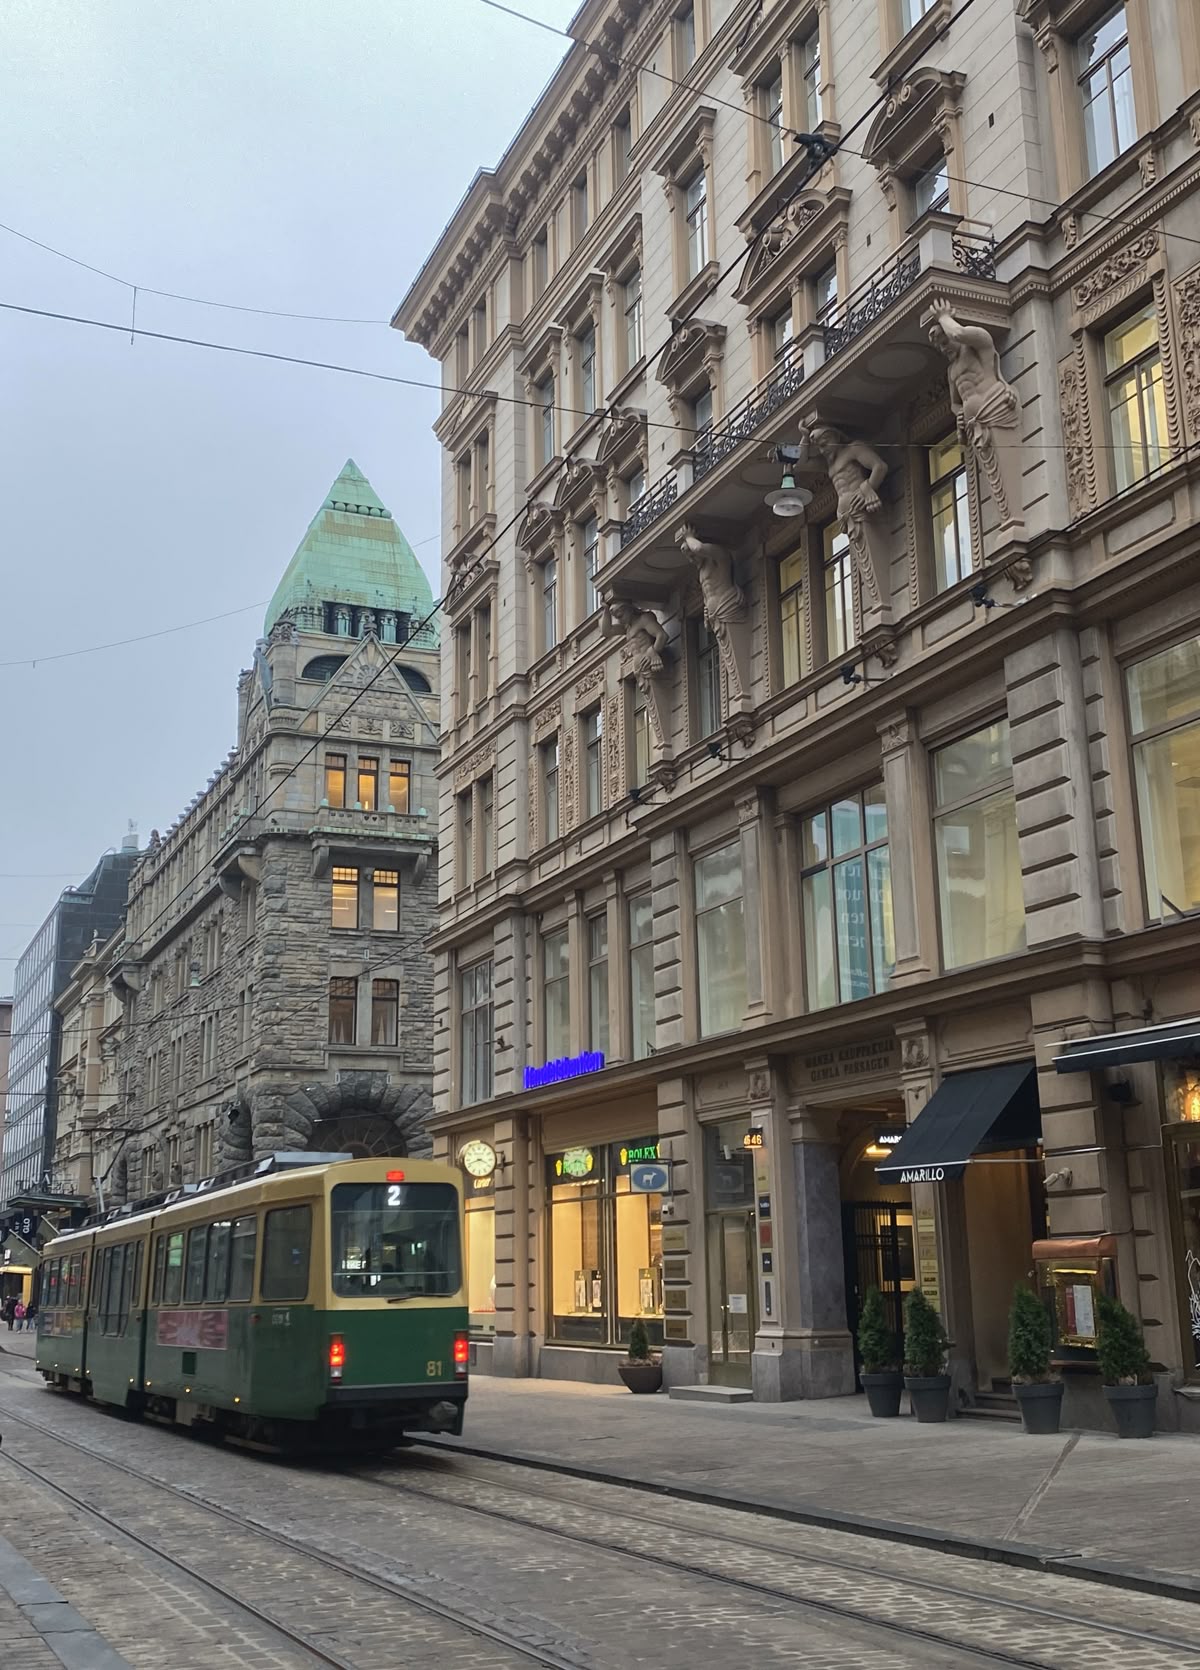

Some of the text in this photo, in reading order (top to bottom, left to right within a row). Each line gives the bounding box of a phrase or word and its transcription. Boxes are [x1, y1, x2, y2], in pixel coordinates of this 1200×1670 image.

[523, 1050, 605, 1089] Handelsbanken
[751, 1134, 762, 1145] 46
[900, 1167, 945, 1184] AMARILLO
[387, 1184, 401, 1206] 2
[426, 1360, 442, 1377] 81
